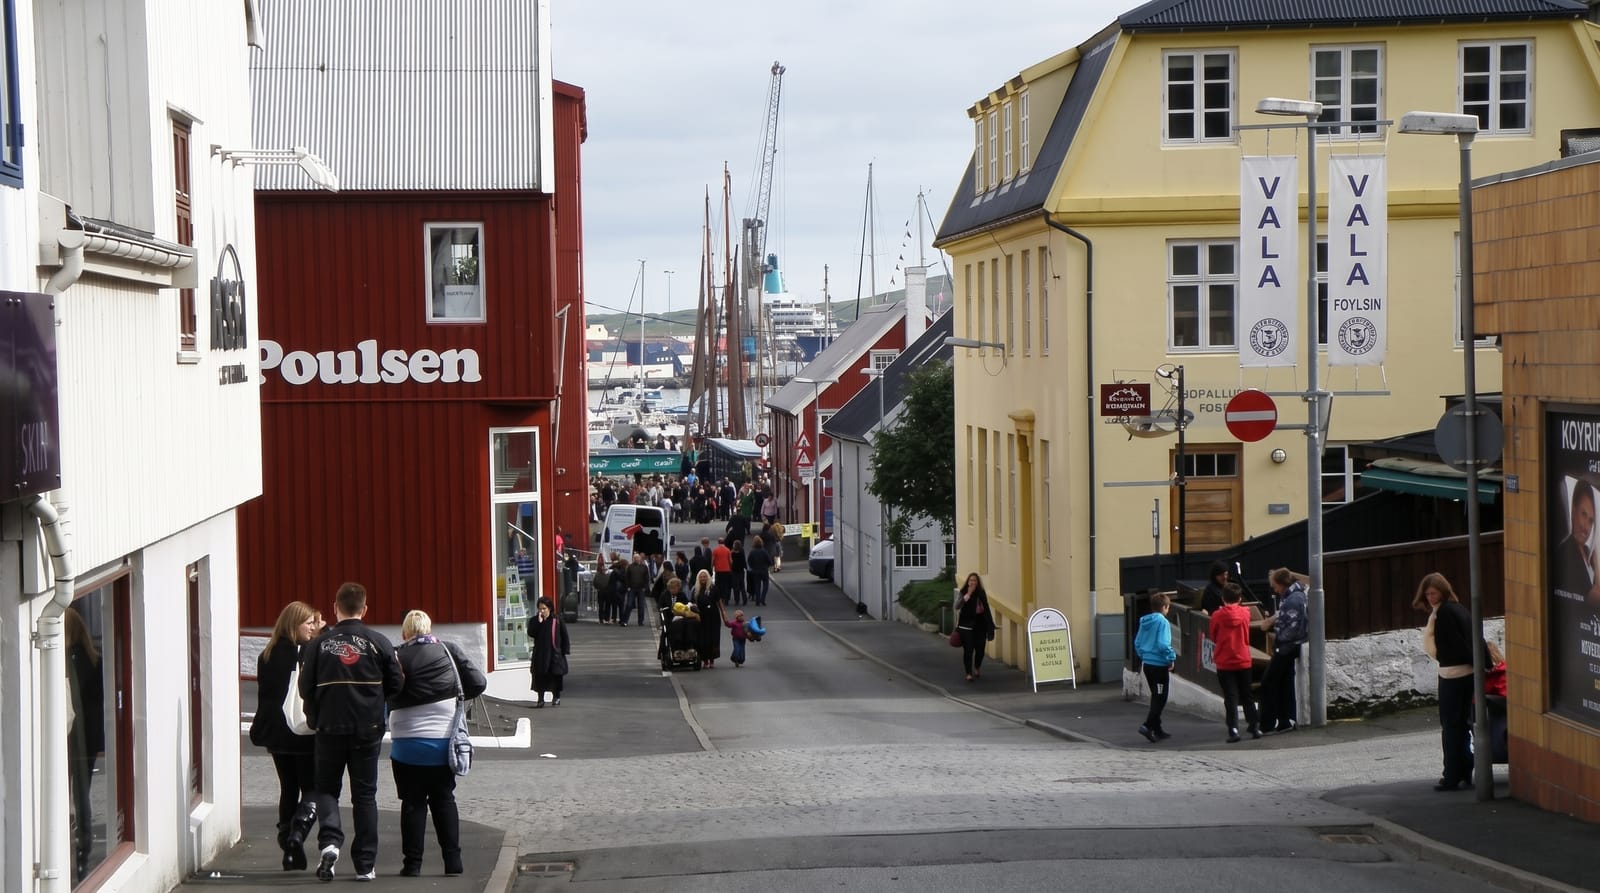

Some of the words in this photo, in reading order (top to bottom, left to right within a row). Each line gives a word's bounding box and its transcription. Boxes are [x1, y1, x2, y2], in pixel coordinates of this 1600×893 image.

[1257, 176, 1281, 288] VALA
[1346, 174, 1370, 286] VALA
[1333, 298, 1382, 311] FOYLSIN
[258, 339, 482, 385] Poulsen
[21, 421, 48, 475] SKIN
